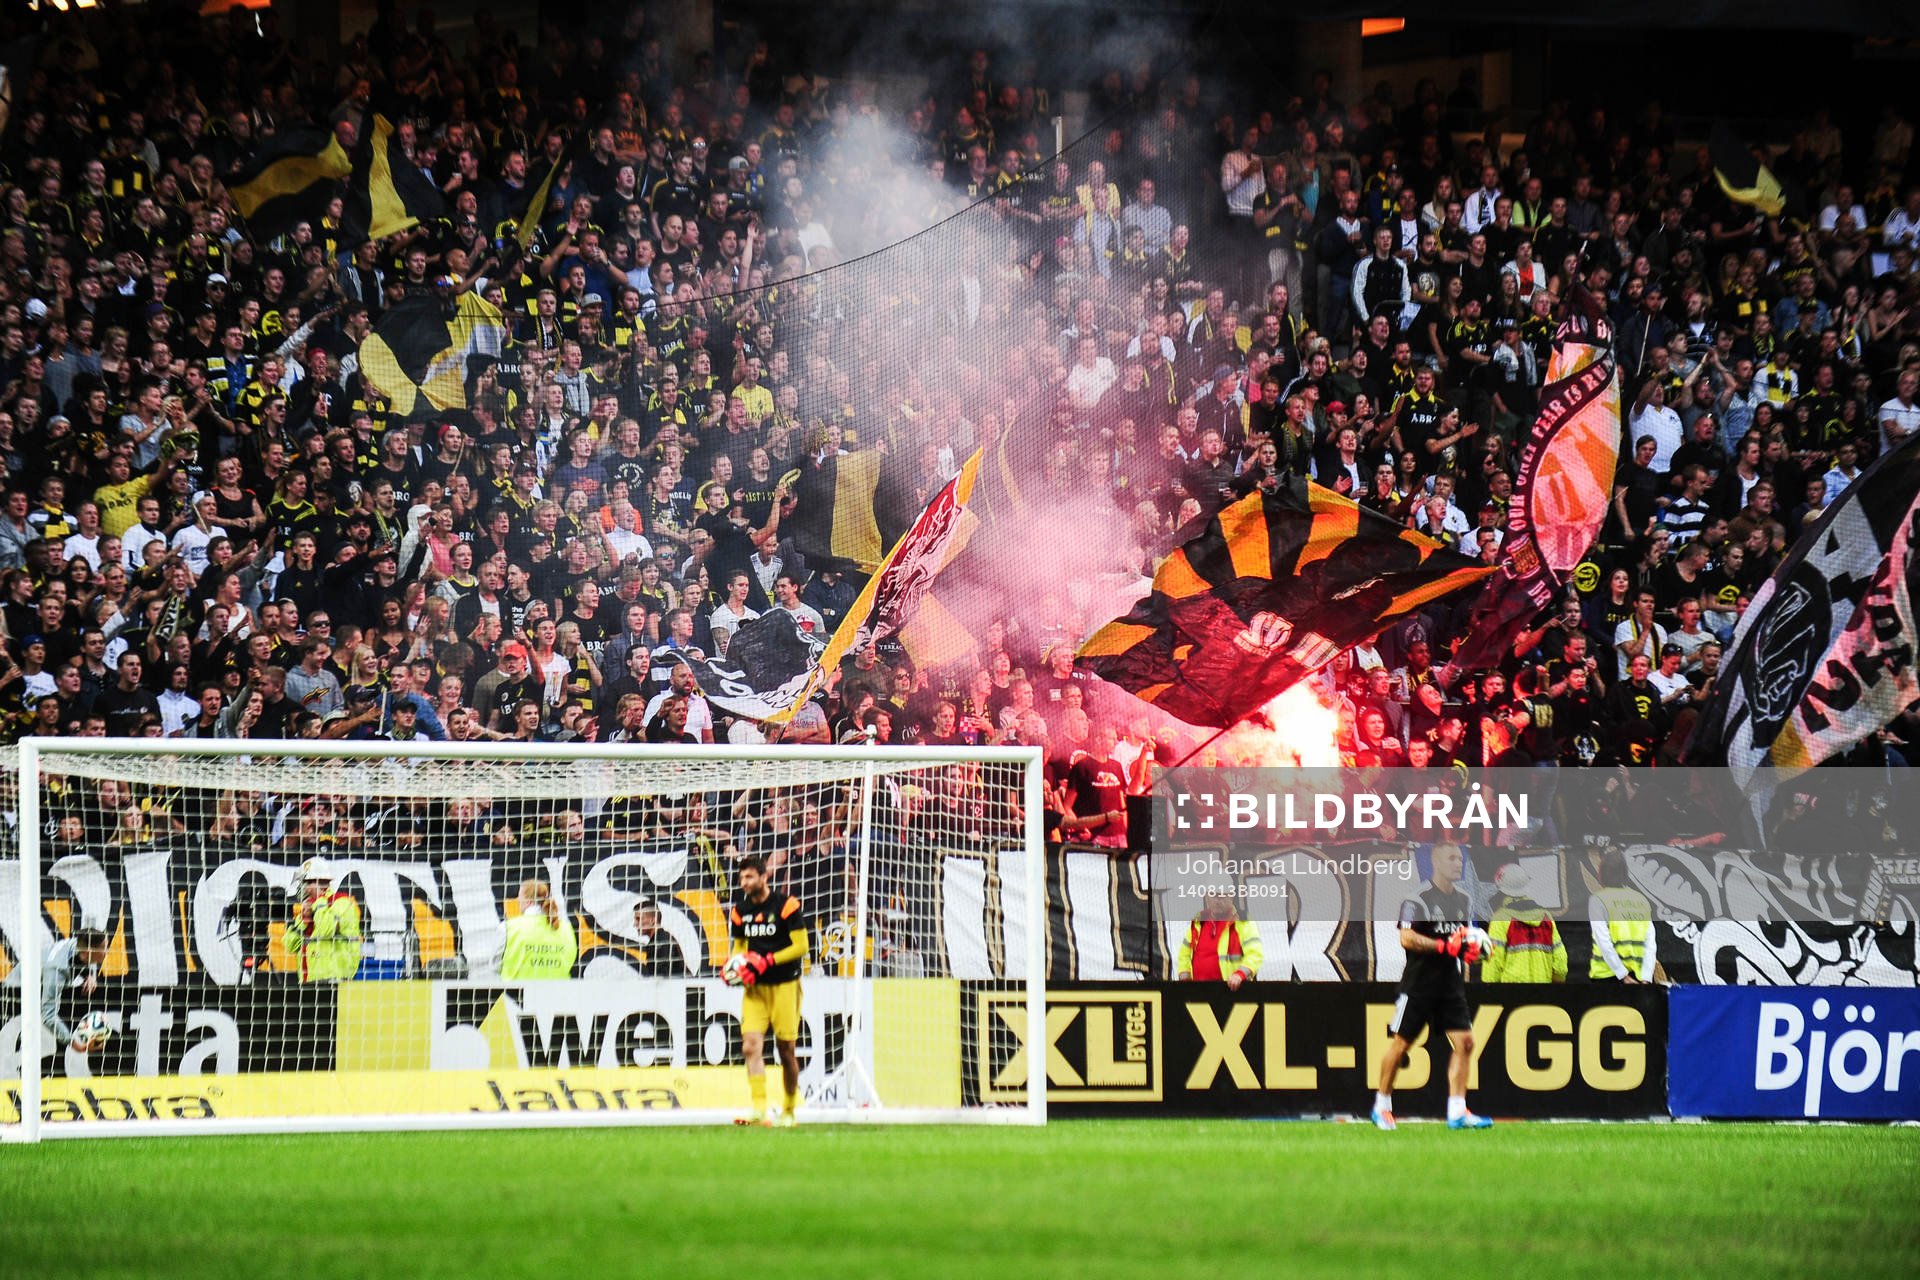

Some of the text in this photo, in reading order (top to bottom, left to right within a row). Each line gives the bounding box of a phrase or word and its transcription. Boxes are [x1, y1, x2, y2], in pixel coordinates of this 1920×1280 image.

[1508, 494, 1528, 532] OUR
[1531, 399, 1567, 439] FEAR
[1563, 384, 1583, 406] IS
[993, 1005, 1148, 1087] XL
